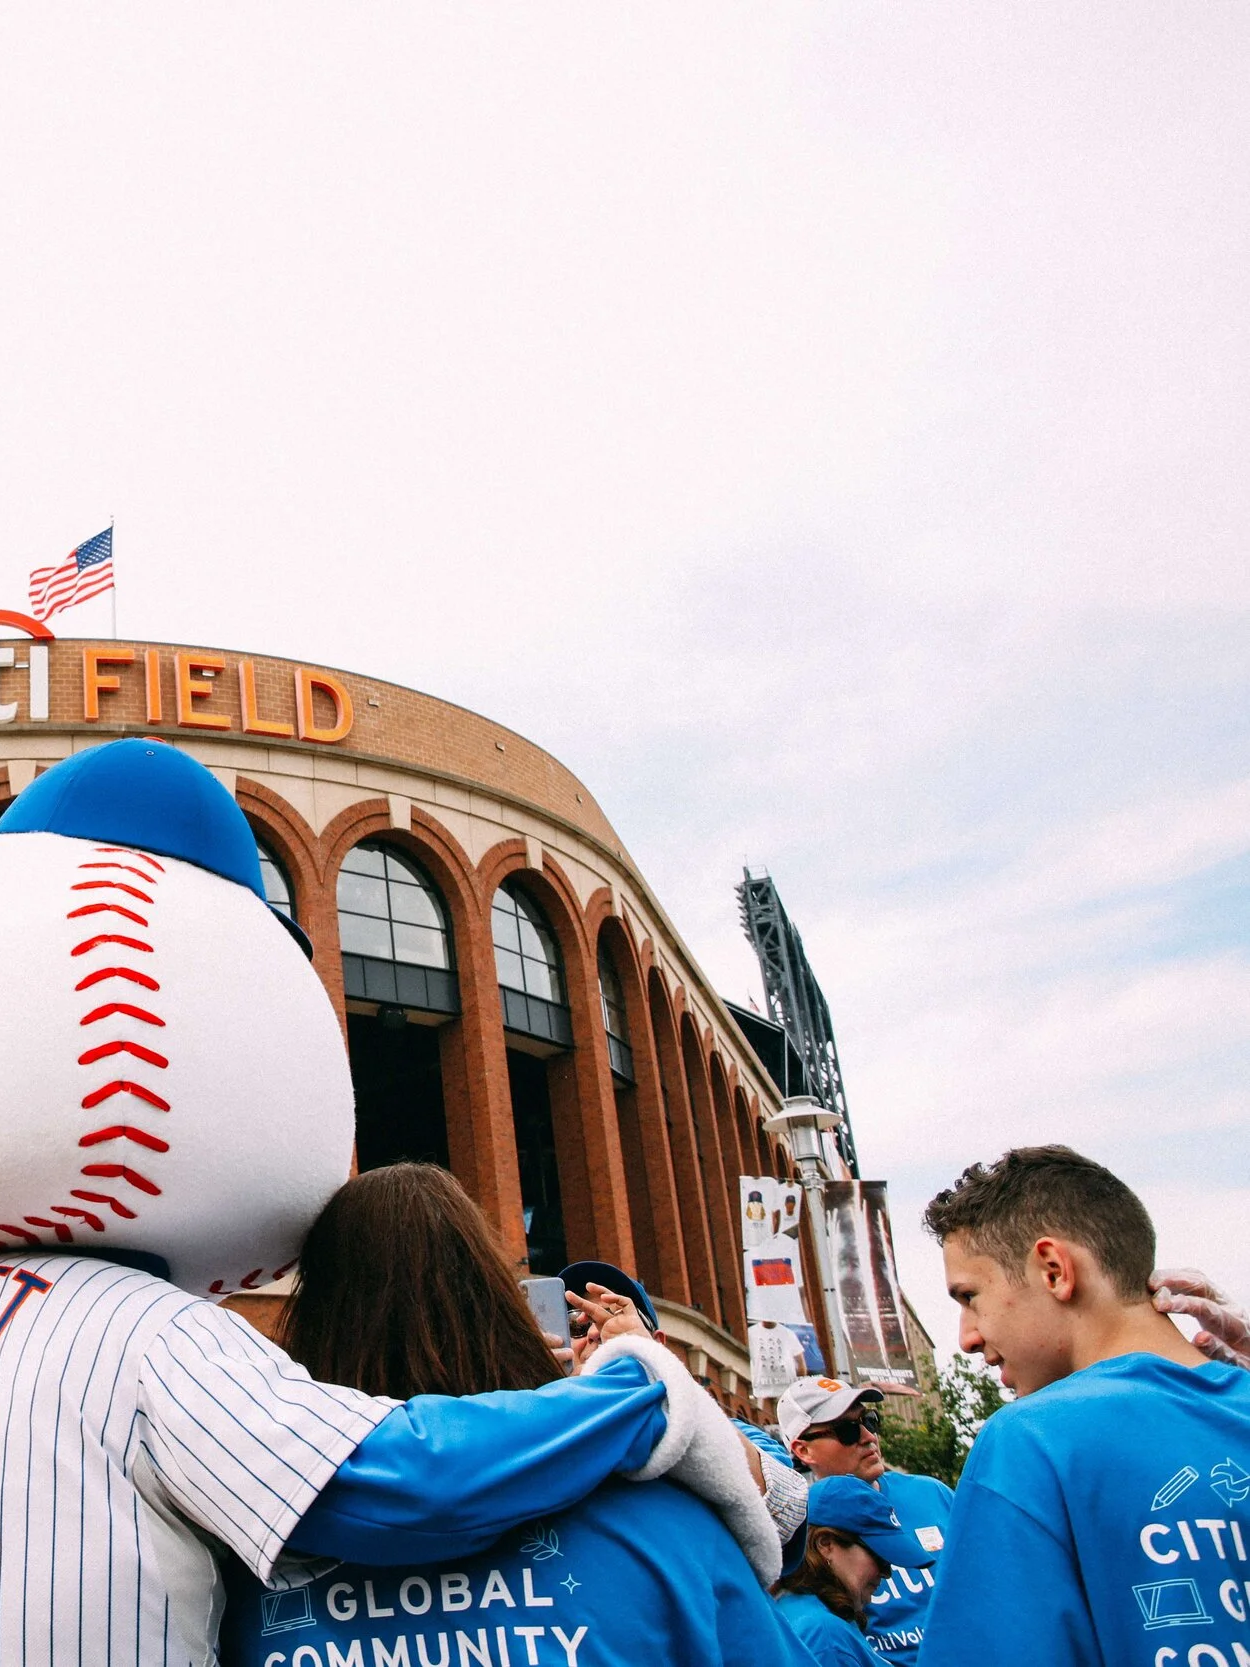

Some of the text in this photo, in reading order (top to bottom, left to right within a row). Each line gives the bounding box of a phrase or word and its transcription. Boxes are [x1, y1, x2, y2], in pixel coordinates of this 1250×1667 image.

[82, 647, 354, 742] FIELD
[1140, 1519, 1247, 1564] CITI
[326, 1568, 554, 1621] GLOBAL
